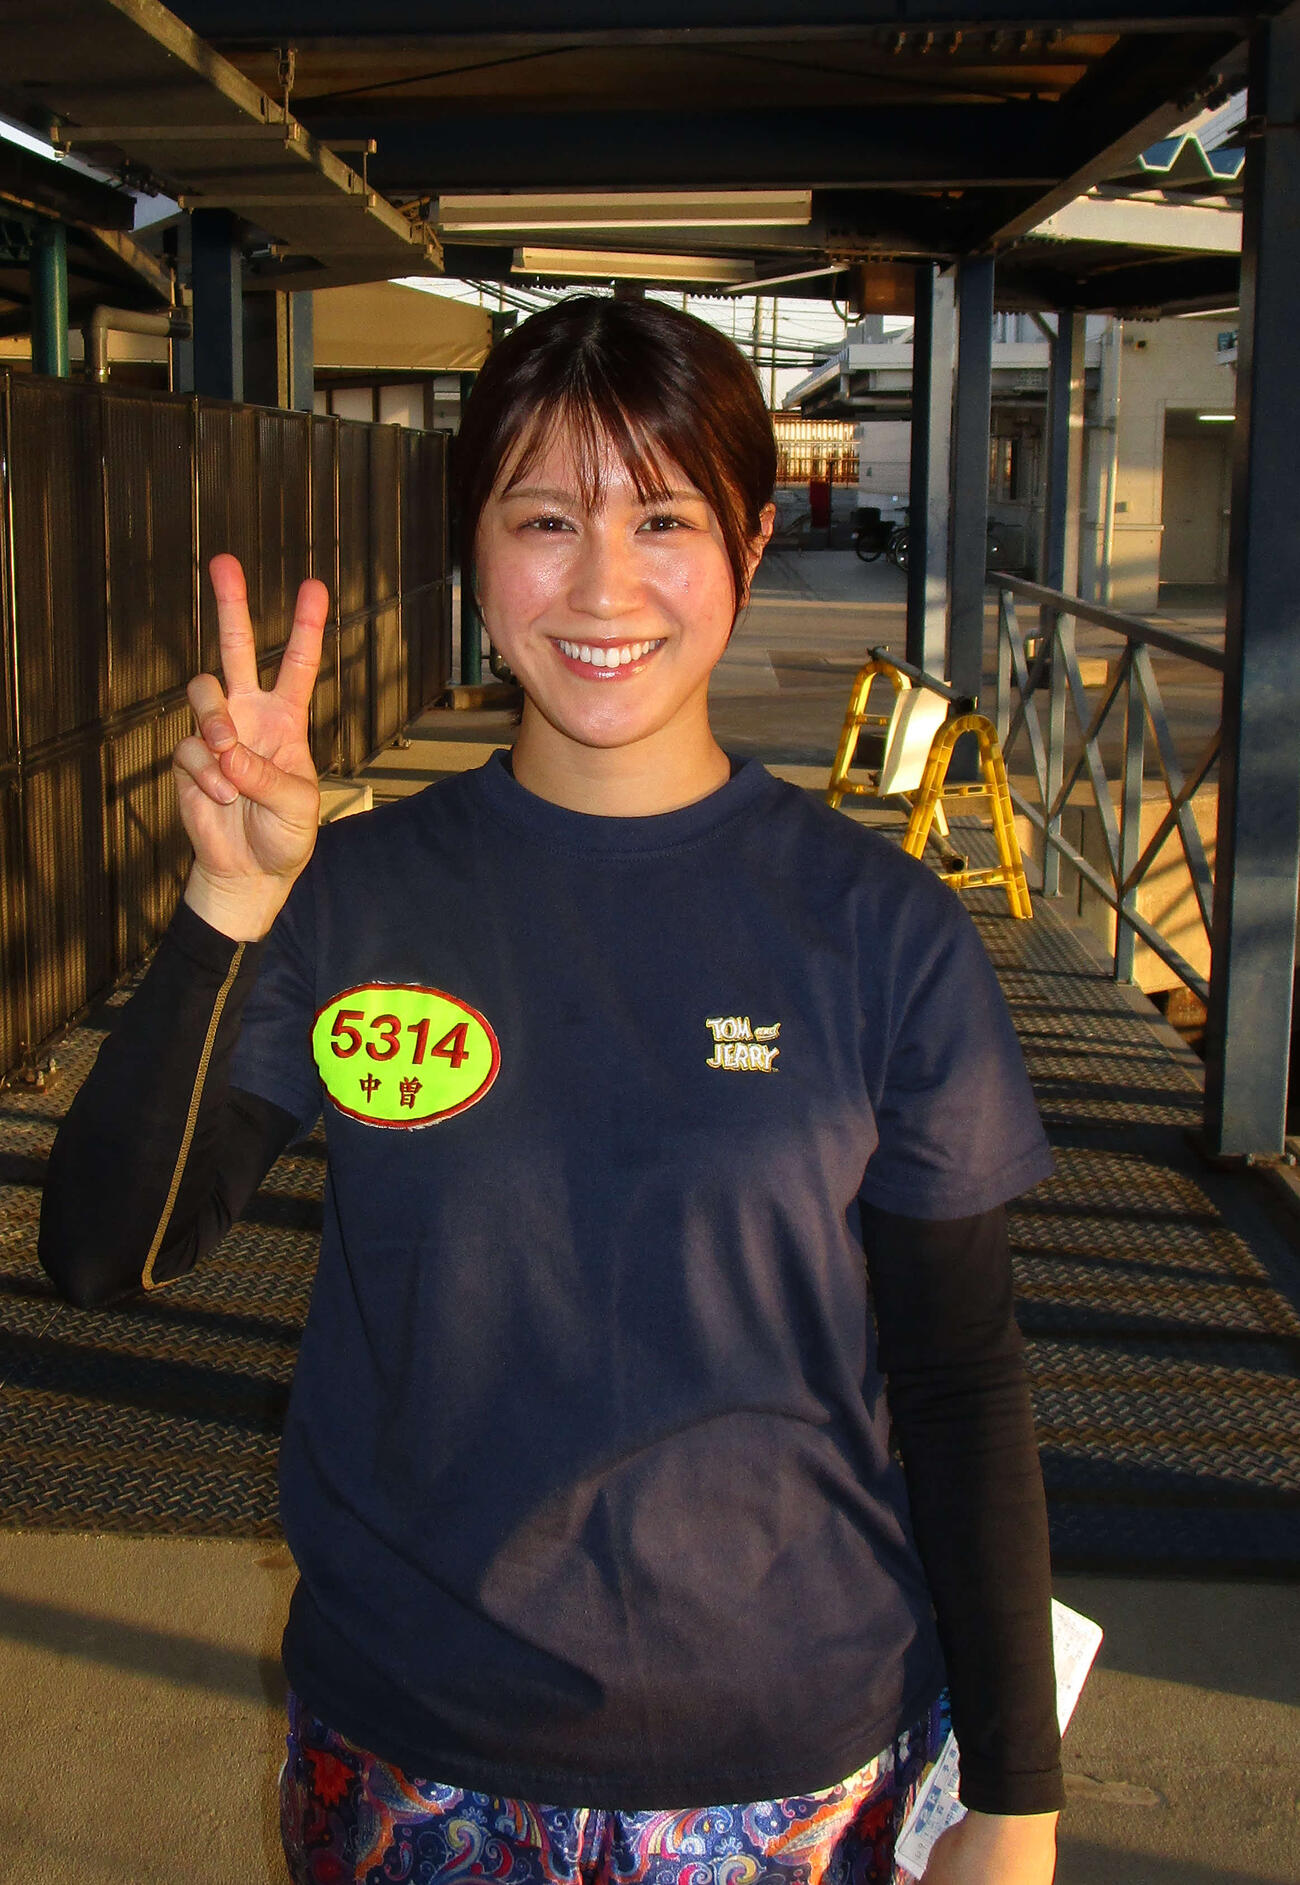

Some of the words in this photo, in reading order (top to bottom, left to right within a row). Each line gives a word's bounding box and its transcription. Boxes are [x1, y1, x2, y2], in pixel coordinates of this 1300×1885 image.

[331, 1009, 469, 1068] 5314
[706, 1016, 753, 1042] TOM
[706, 1042, 780, 1072] JERRY
